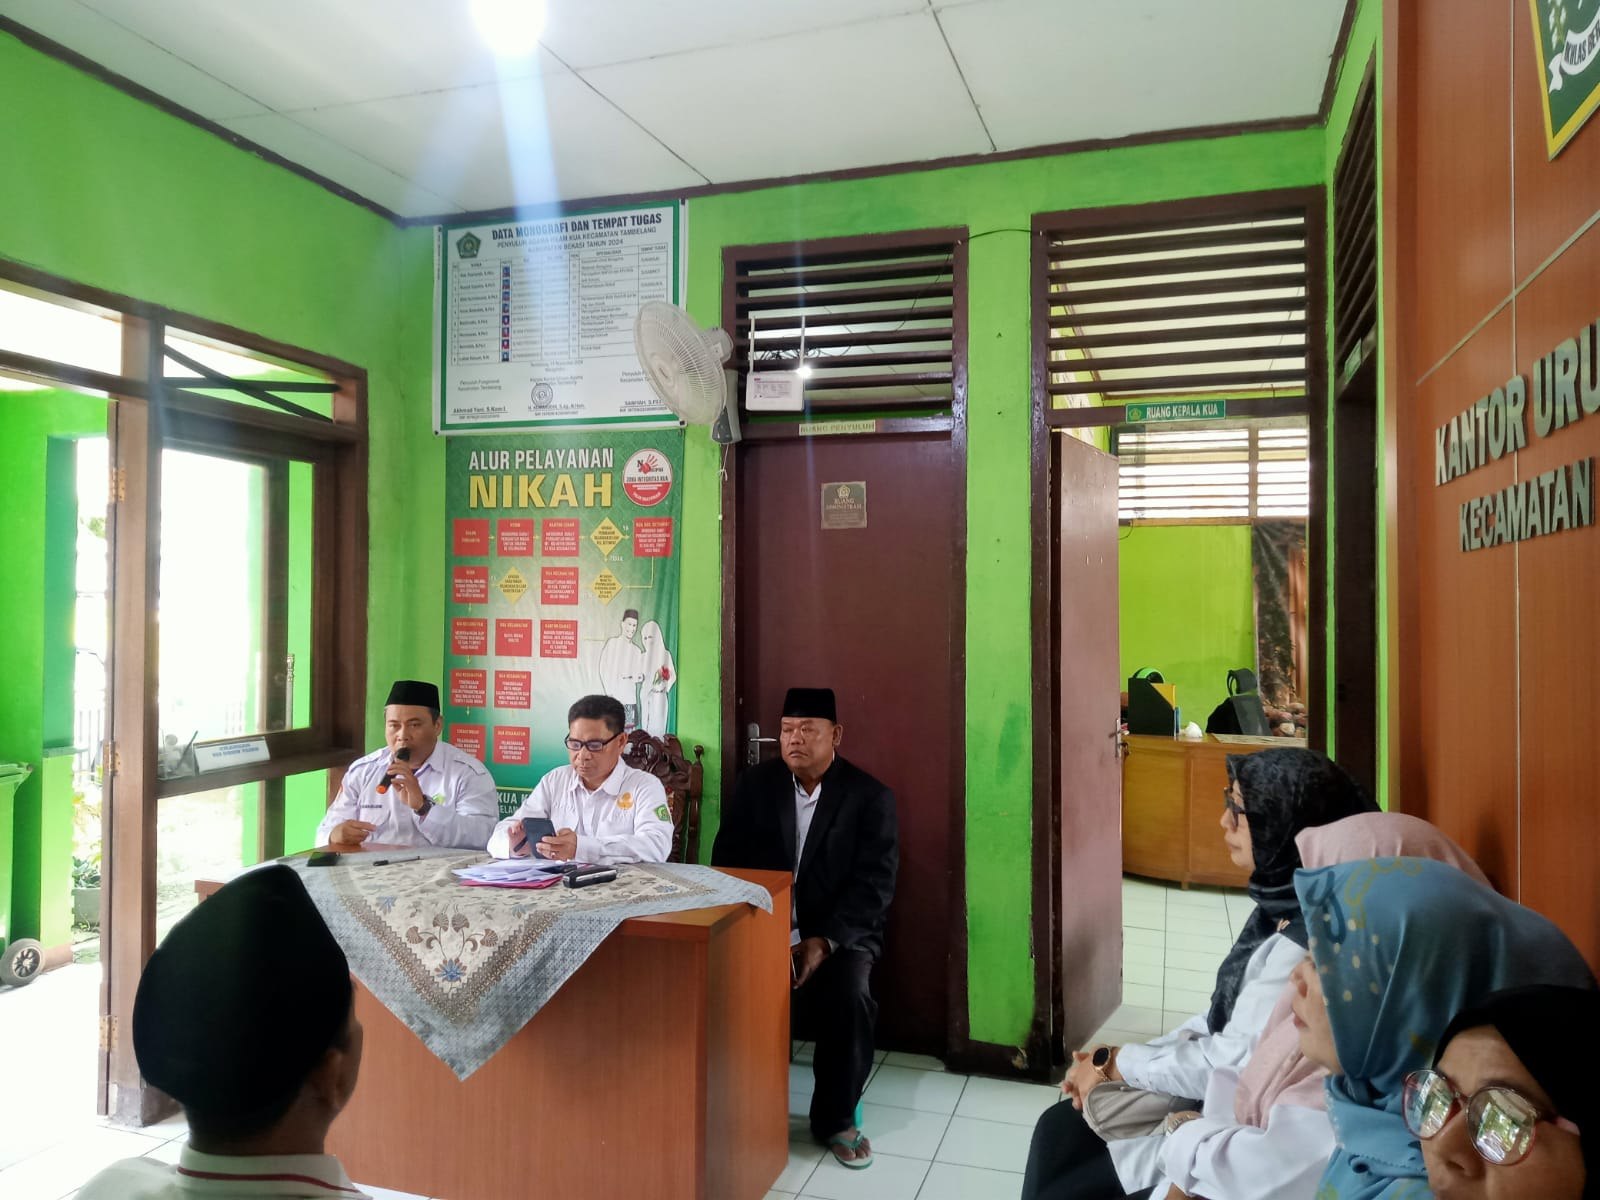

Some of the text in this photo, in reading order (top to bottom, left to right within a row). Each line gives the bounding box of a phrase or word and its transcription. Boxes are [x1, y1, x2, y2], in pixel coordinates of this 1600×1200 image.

[492, 212, 662, 241] DATA MONOGRAFI DAN TEMPAT TUGAS
[582, 230, 619, 241] KECAMATAN
[620, 226, 657, 237] TAMBELANG
[563, 241, 585, 250] BEKASI
[586, 239, 607, 249] TAHUN
[1146, 403, 1218, 419] RUANG KEPALA KUA
[1435, 374, 1526, 487] KANTOR
[469, 447, 614, 471] ALUR PELAYANAN
[469, 472, 613, 509] NIKAH
[1459, 456, 1595, 553] KECAMATAN
[496, 792, 518, 804] KUA
